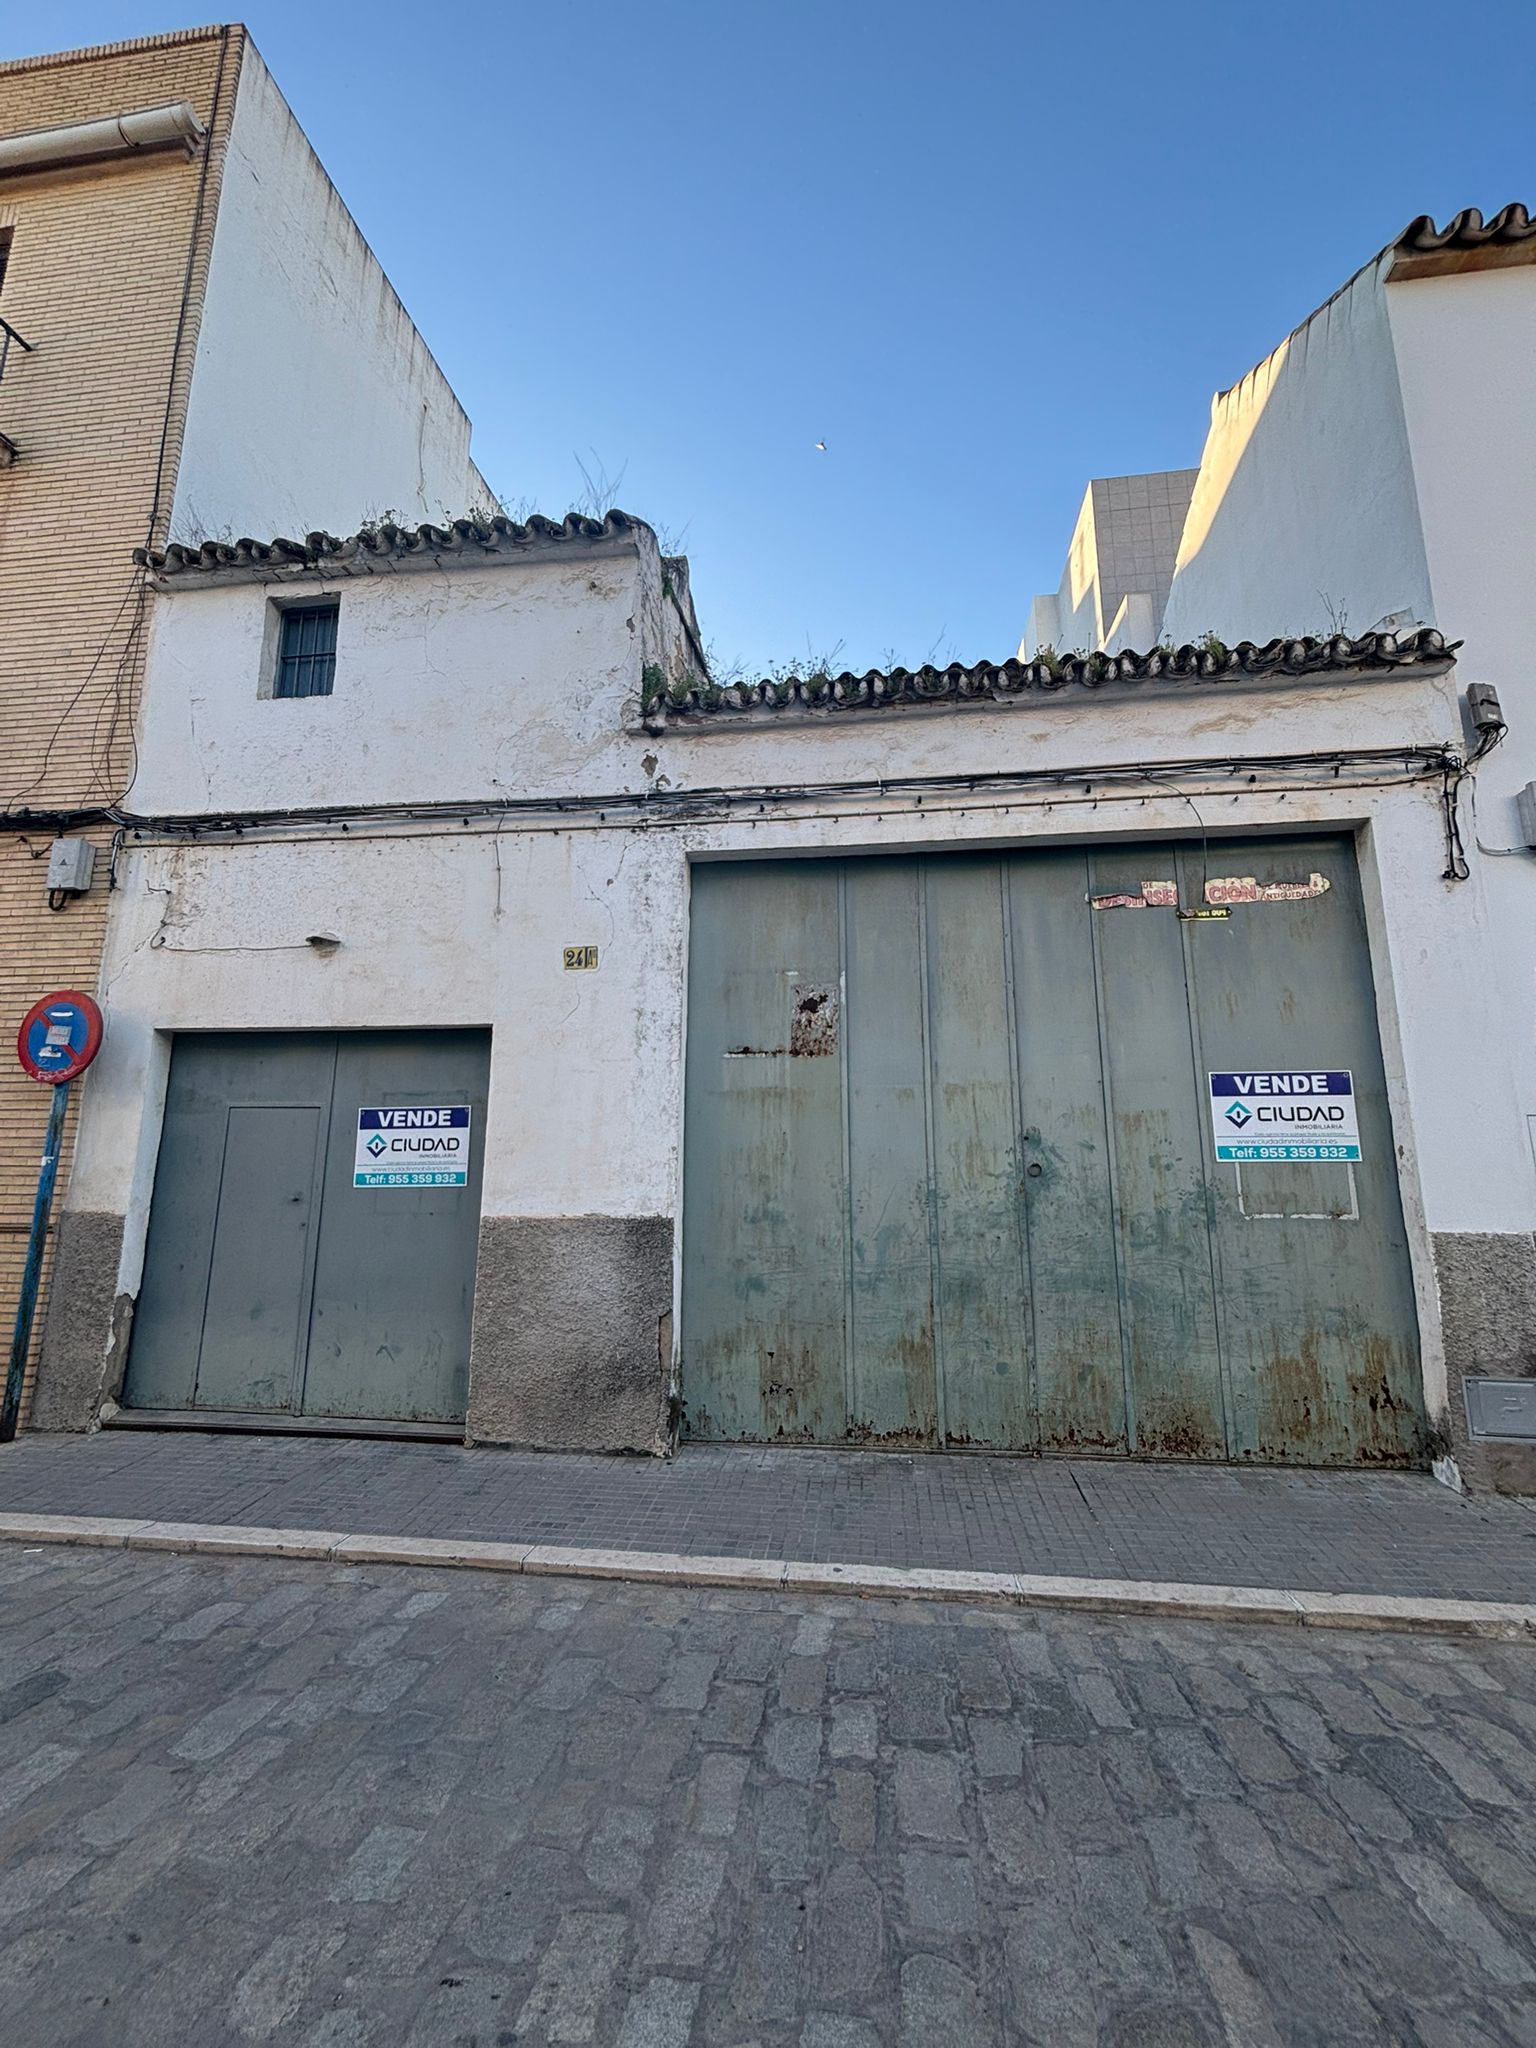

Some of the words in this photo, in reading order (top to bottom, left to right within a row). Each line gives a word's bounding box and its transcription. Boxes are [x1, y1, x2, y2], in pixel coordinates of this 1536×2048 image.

[566, 949, 583, 966] 24
[1233, 1075, 1329, 1094] VENDE
[378, 1110, 452, 1127] VENDE
[1257, 1106, 1344, 1122] CIUDAD
[391, 1138, 460, 1152] CIUDAD
[1229, 1147, 1257, 1158] Telf:
[1260, 1147, 1287, 1158] 955
[1289, 1147, 1317, 1158] 359
[1319, 1147, 1348, 1157] 932
[365, 1174, 387, 1184] Telf:
[388, 1174, 410, 1184] 955
[411, 1174, 433, 1183] 359
[435, 1173, 457, 1183] 932
